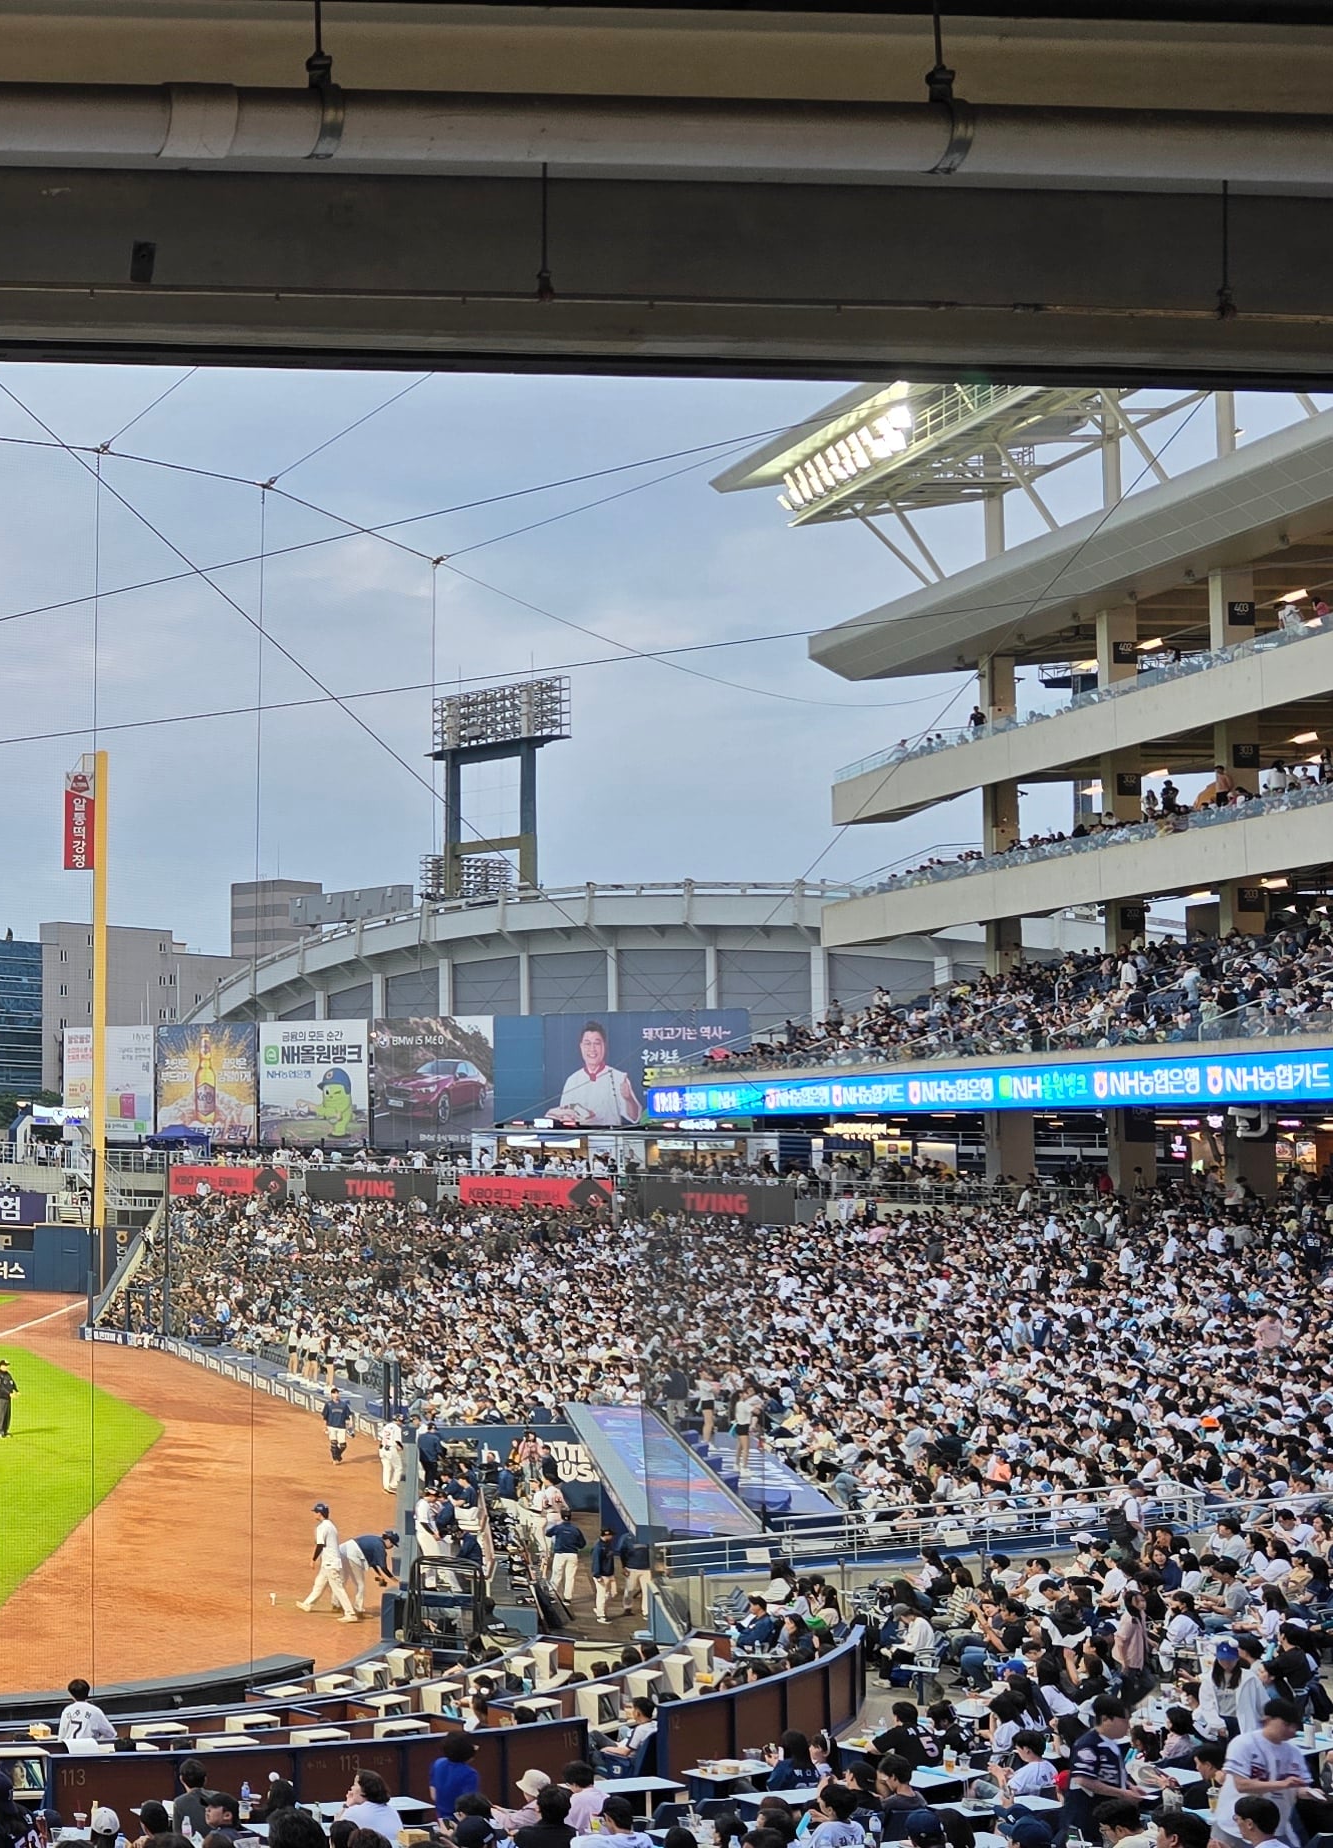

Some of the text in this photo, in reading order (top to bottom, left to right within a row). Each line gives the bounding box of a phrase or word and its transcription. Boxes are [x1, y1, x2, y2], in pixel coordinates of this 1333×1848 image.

[1234, 603, 1249, 613] 403
[1119, 643, 1132, 652] 402
[308, 1031, 324, 1041] 모든
[392, 1036, 414, 1046] BMW
[642, 1026, 697, 1040] 돼지고기는
[282, 1044, 363, 1064] NH올원뱅크
[1012, 1073, 1088, 1100] NH올원뱅크
[1110, 1066, 1200, 1096] NH농협은행
[1226, 1063, 1331, 1092] NH농협카드
[922, 1077, 994, 1105] NH농협은행
[345, 1180, 395, 1197] TVING
[681, 1192, 749, 1214] TVING
[71, 1720, 82, 1739] 7
[563, 1731, 579, 1747] 113
[919, 1736, 939, 1758] 5
[339, 1754, 360, 1772] 113
[61, 1768, 86, 1787] 113
